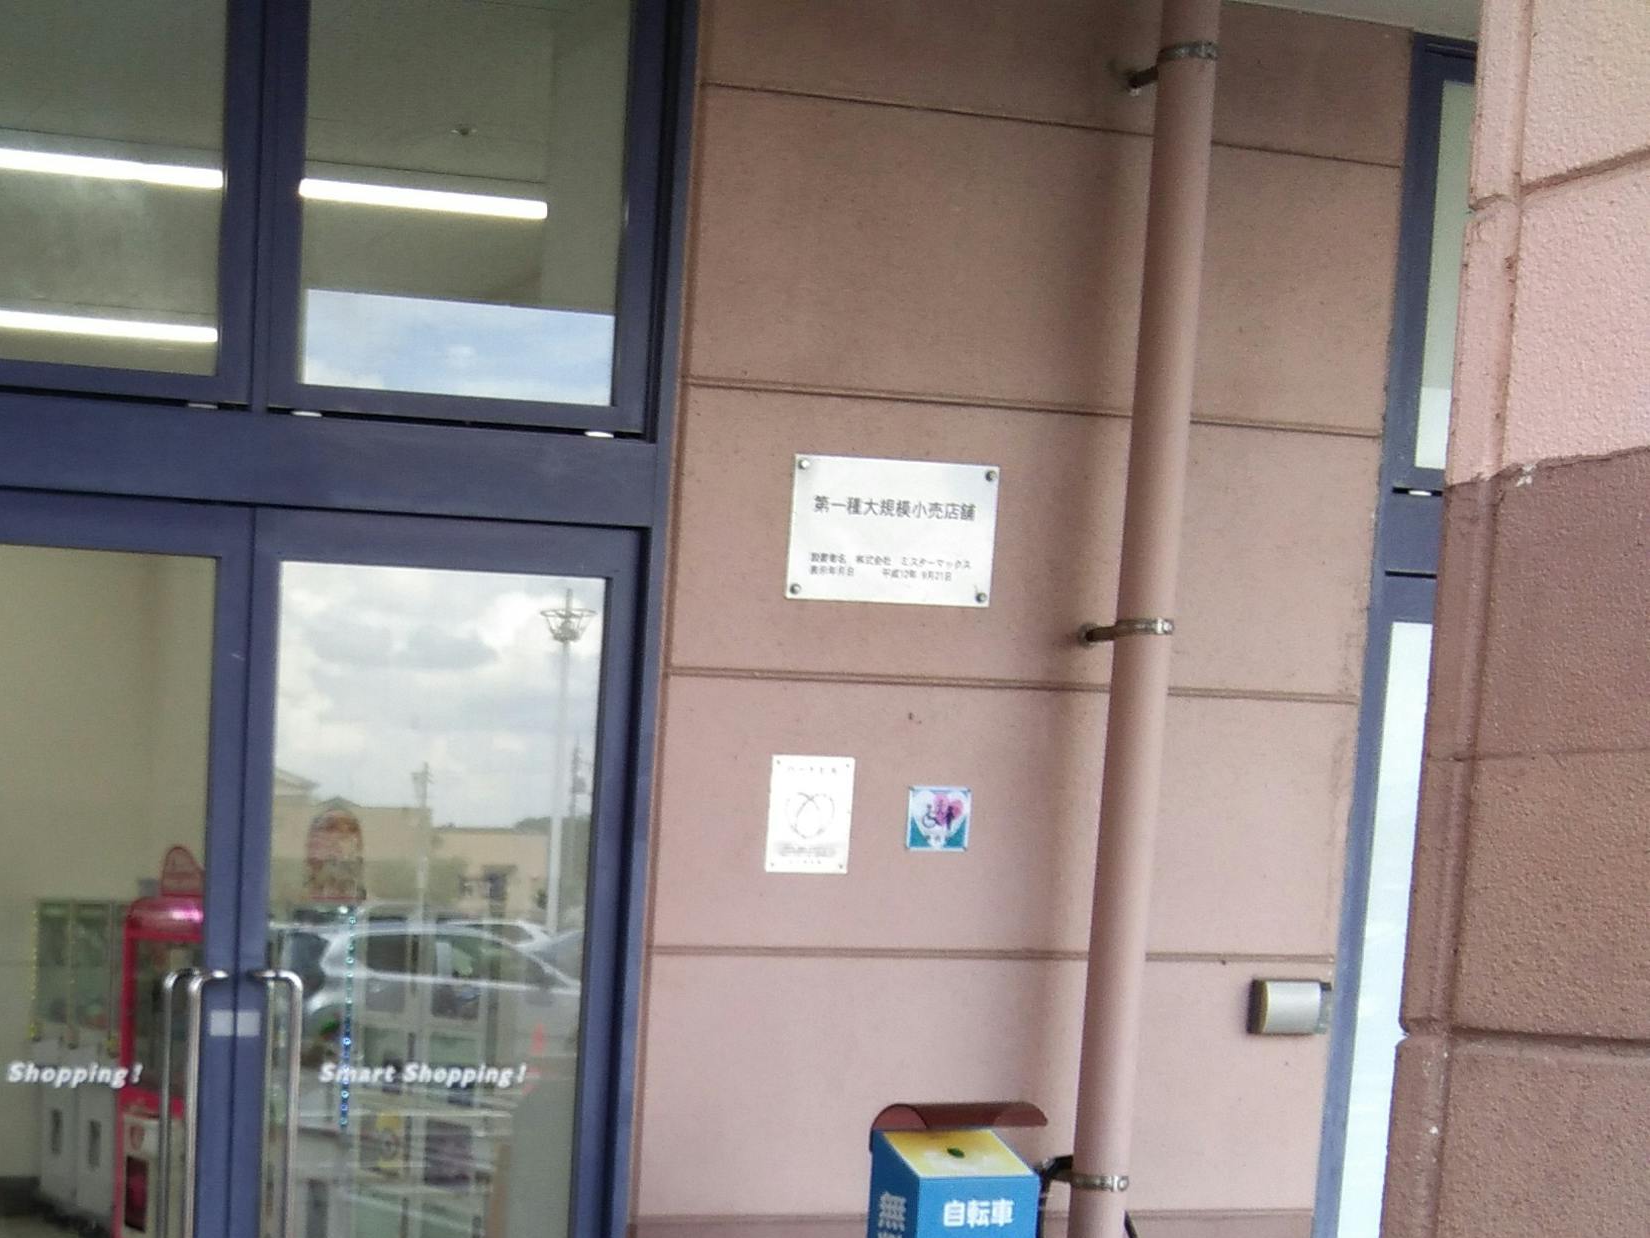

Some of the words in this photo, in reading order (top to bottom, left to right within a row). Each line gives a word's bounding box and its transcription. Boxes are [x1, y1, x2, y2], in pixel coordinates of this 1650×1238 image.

[814, 495, 976, 521] 第一種大規模小売店舗
[6, 1061, 144, 1088] Shopping!
[318, 1061, 401, 1084] Smart
[405, 1061, 528, 1087] Shopping!
[942, 1199, 1015, 1228] 自転車
